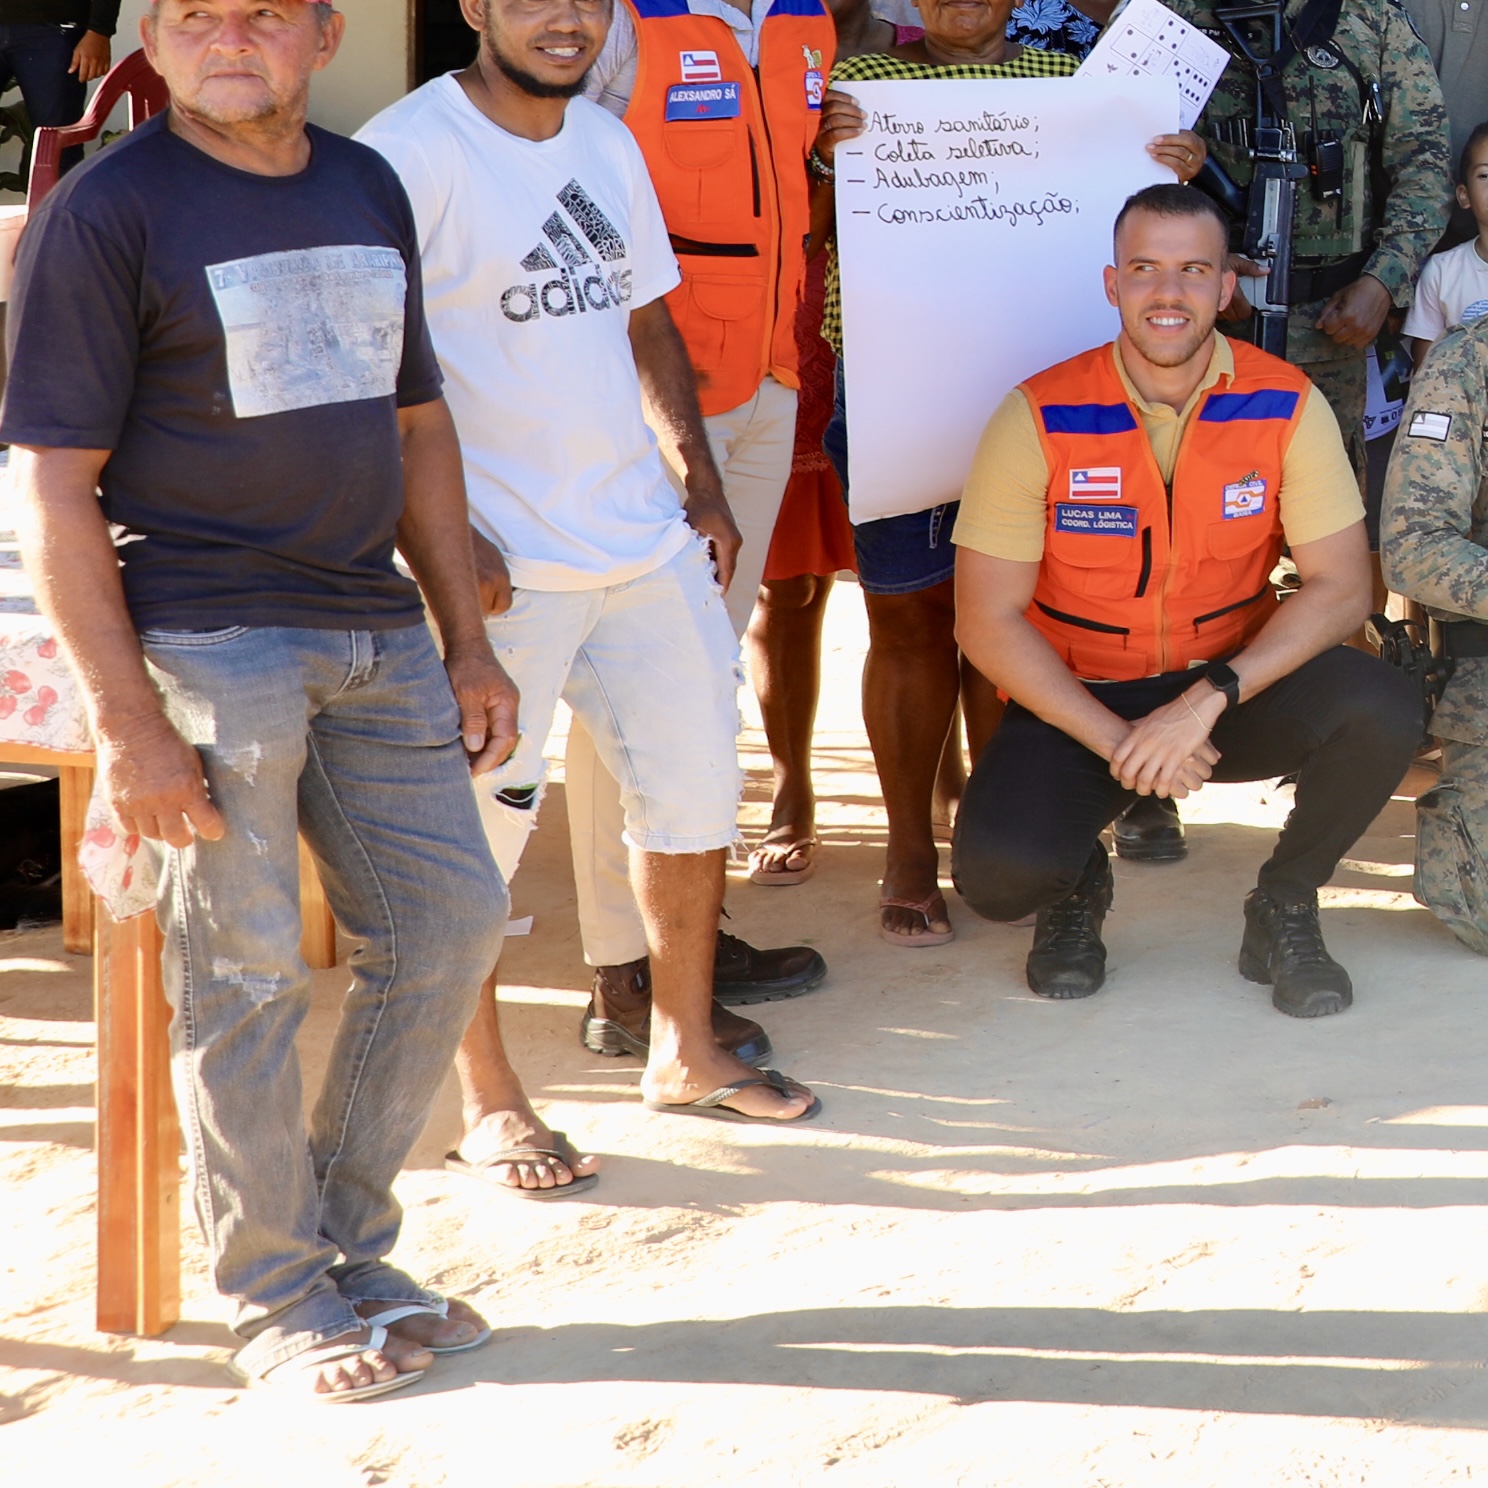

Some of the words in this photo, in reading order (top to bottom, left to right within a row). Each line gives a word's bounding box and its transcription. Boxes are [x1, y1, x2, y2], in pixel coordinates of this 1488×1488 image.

[669, 88, 722, 103] ALEXSANDRO
[724, 84, 737, 100] SÁ
[868, 112, 924, 134] Aterro
[935, 111, 1040, 134] sanitário;
[874, 139, 936, 163] Coleta
[946, 138, 1040, 160] seletiva;
[873, 168, 999, 198] Adubagem;
[878, 192, 1079, 226] Conscientização;
[500, 264, 632, 323] adidas
[1061, 509, 1094, 519] LUCAS
[1098, 511, 1122, 520] LIMA
[1061, 518, 1091, 528] COORD.
[1093, 519, 1133, 530] LÓGISTICA
